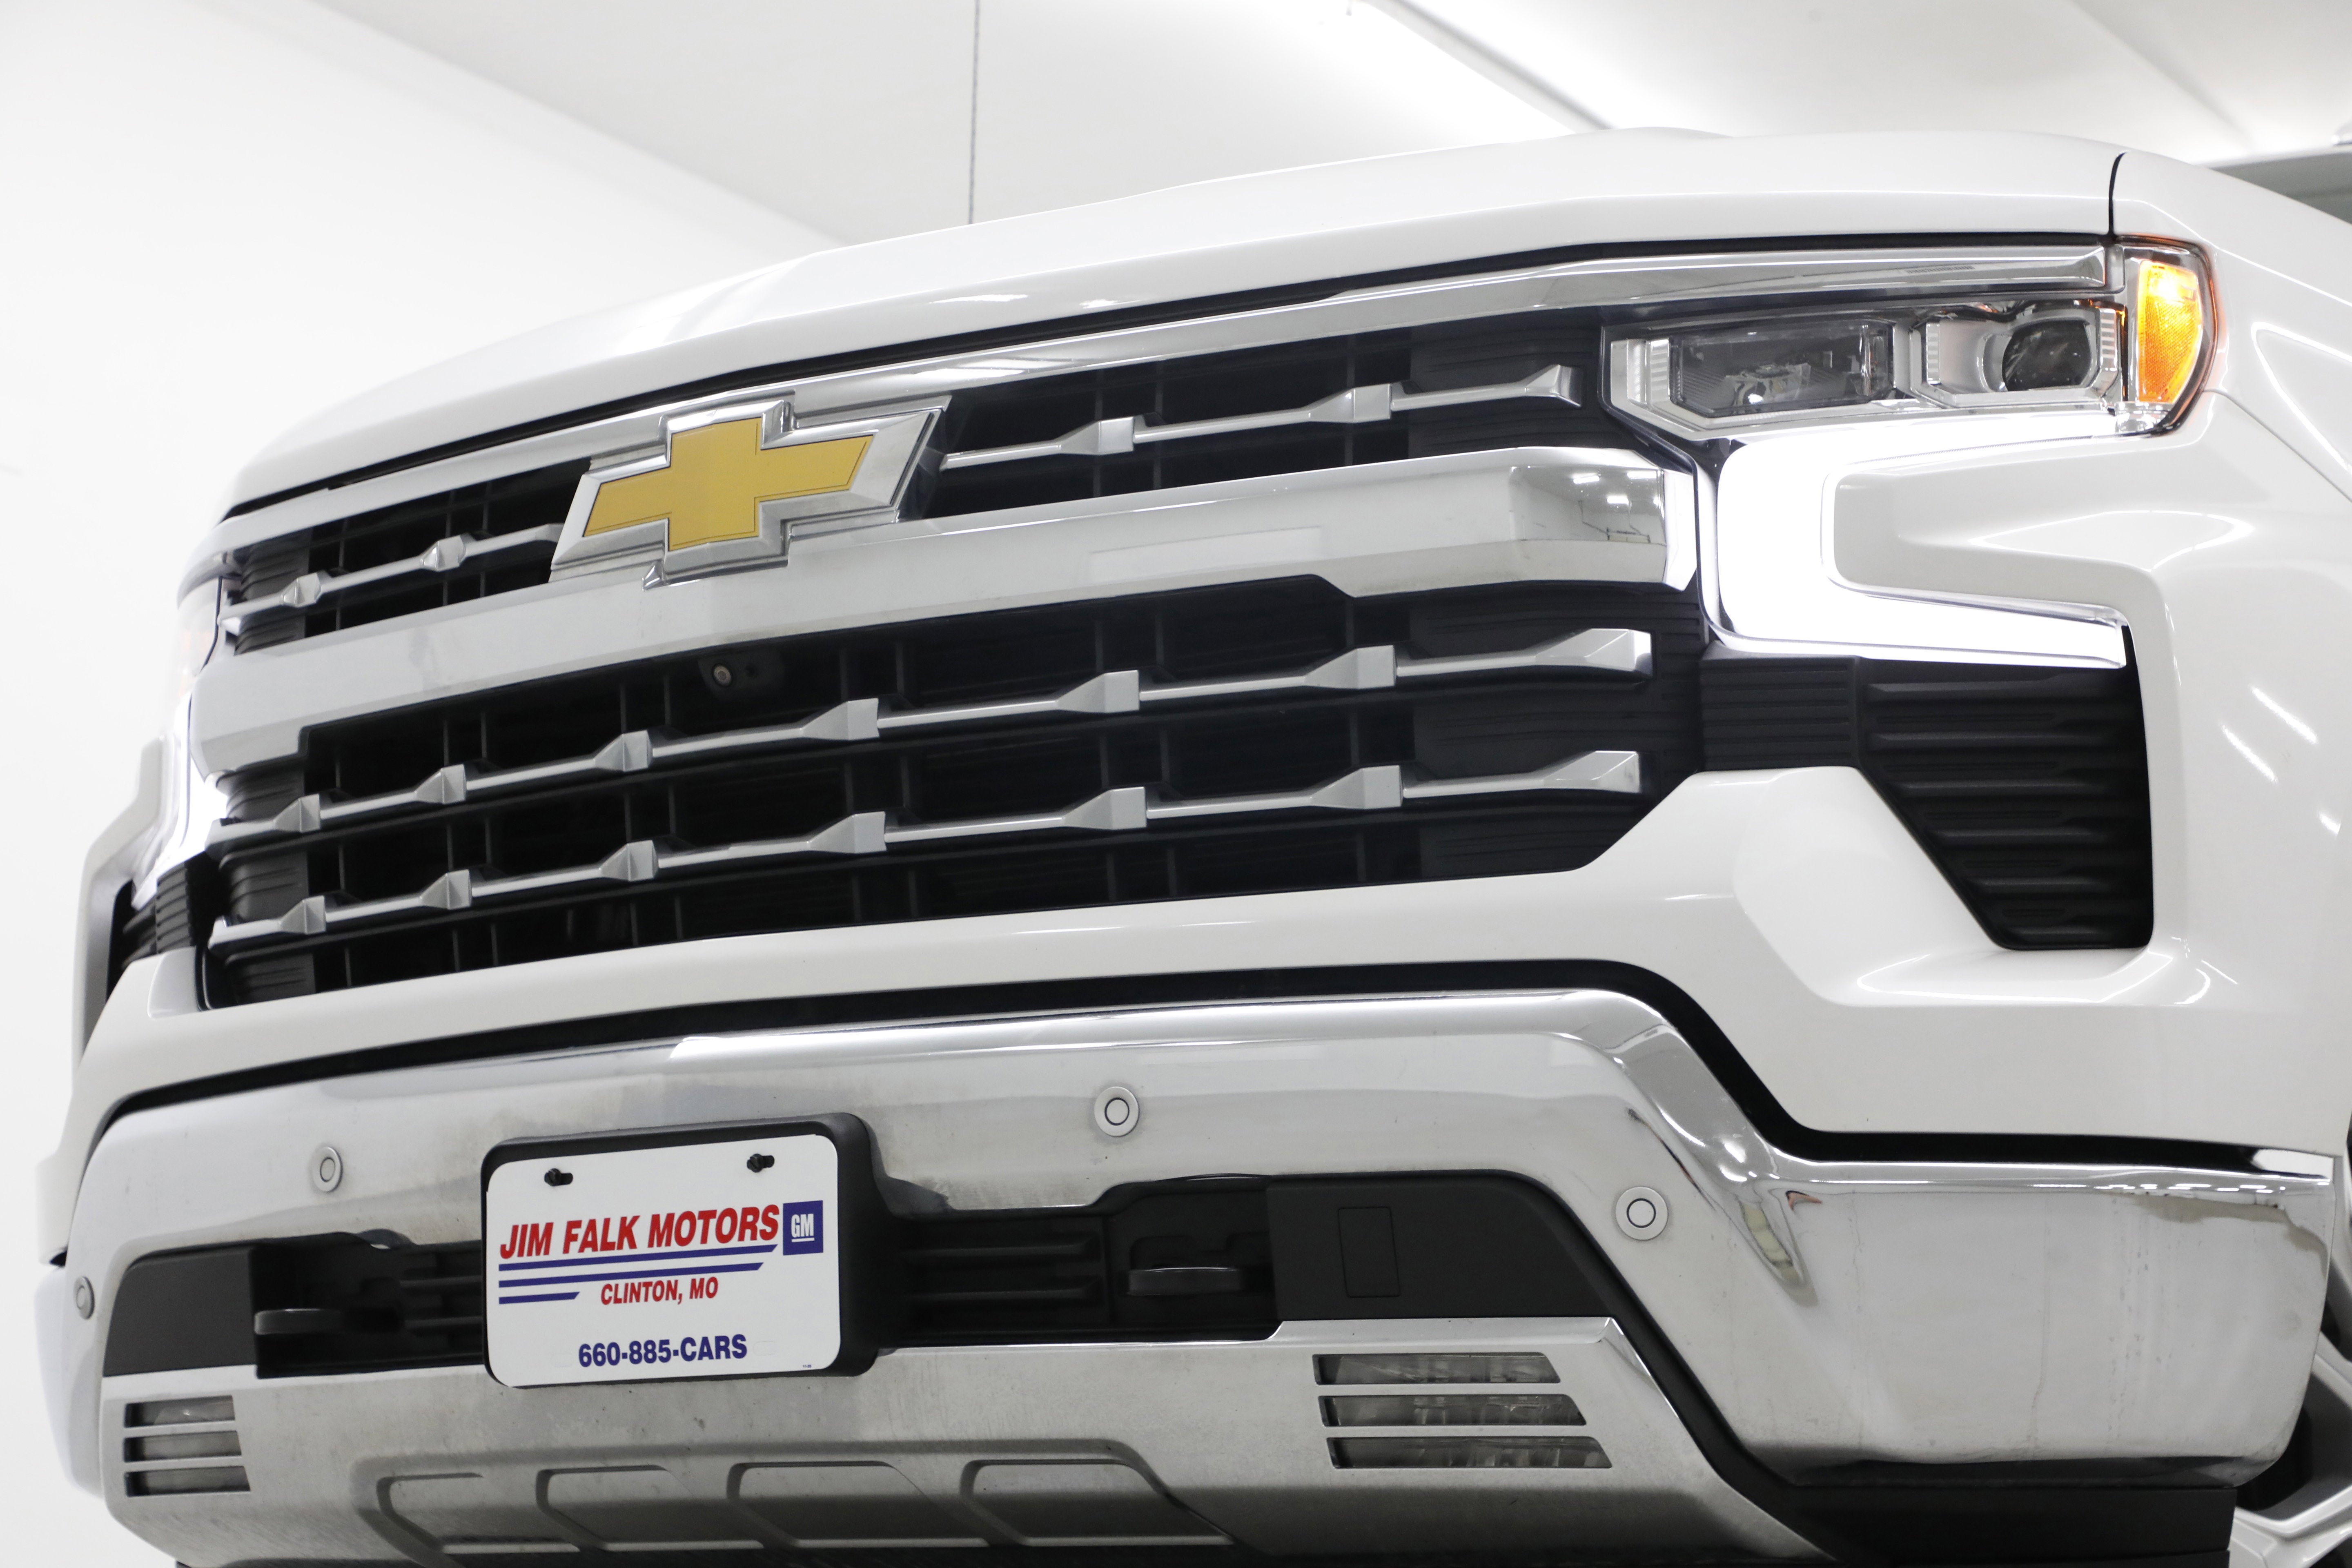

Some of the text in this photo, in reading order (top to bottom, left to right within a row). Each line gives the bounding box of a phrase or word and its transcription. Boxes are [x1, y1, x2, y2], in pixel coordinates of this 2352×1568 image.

[500, 1204, 780, 1259] JIM FALK MOTORS
[791, 1213, 814, 1238] GM
[601, 1276, 719, 1305] CLINTON, MO
[579, 1334, 747, 1368] 660-885-CARS
